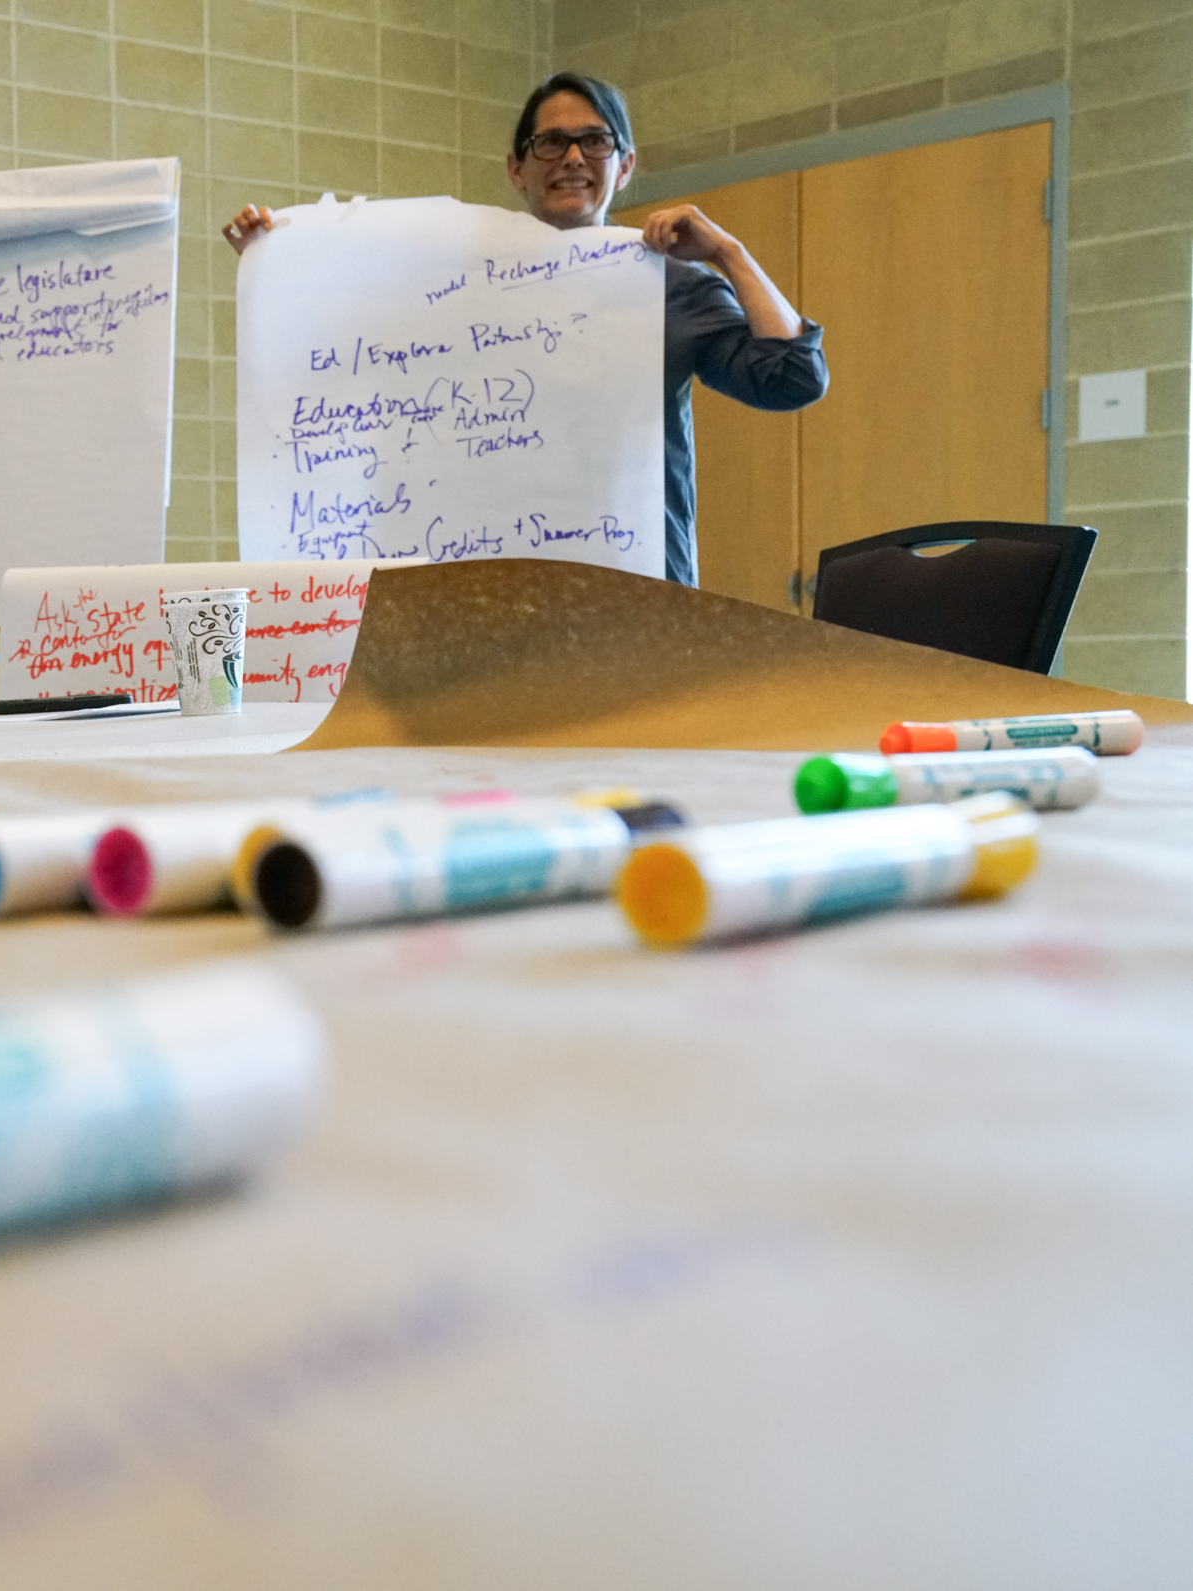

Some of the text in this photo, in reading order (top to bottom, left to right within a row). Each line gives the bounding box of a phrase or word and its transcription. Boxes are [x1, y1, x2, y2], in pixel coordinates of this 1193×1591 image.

[15, 259, 116, 304] legislature
[16, 333, 115, 362] educators
[310, 347, 341, 372] Ed
[283, 436, 389, 480] Training
[289, 482, 411, 534] Materials
[425, 515, 504, 562] Credits
[34, 590, 79, 634] Ask
[87, 600, 146, 633] state
[268, 581, 292, 604] to
[69, 642, 134, 679] energy
